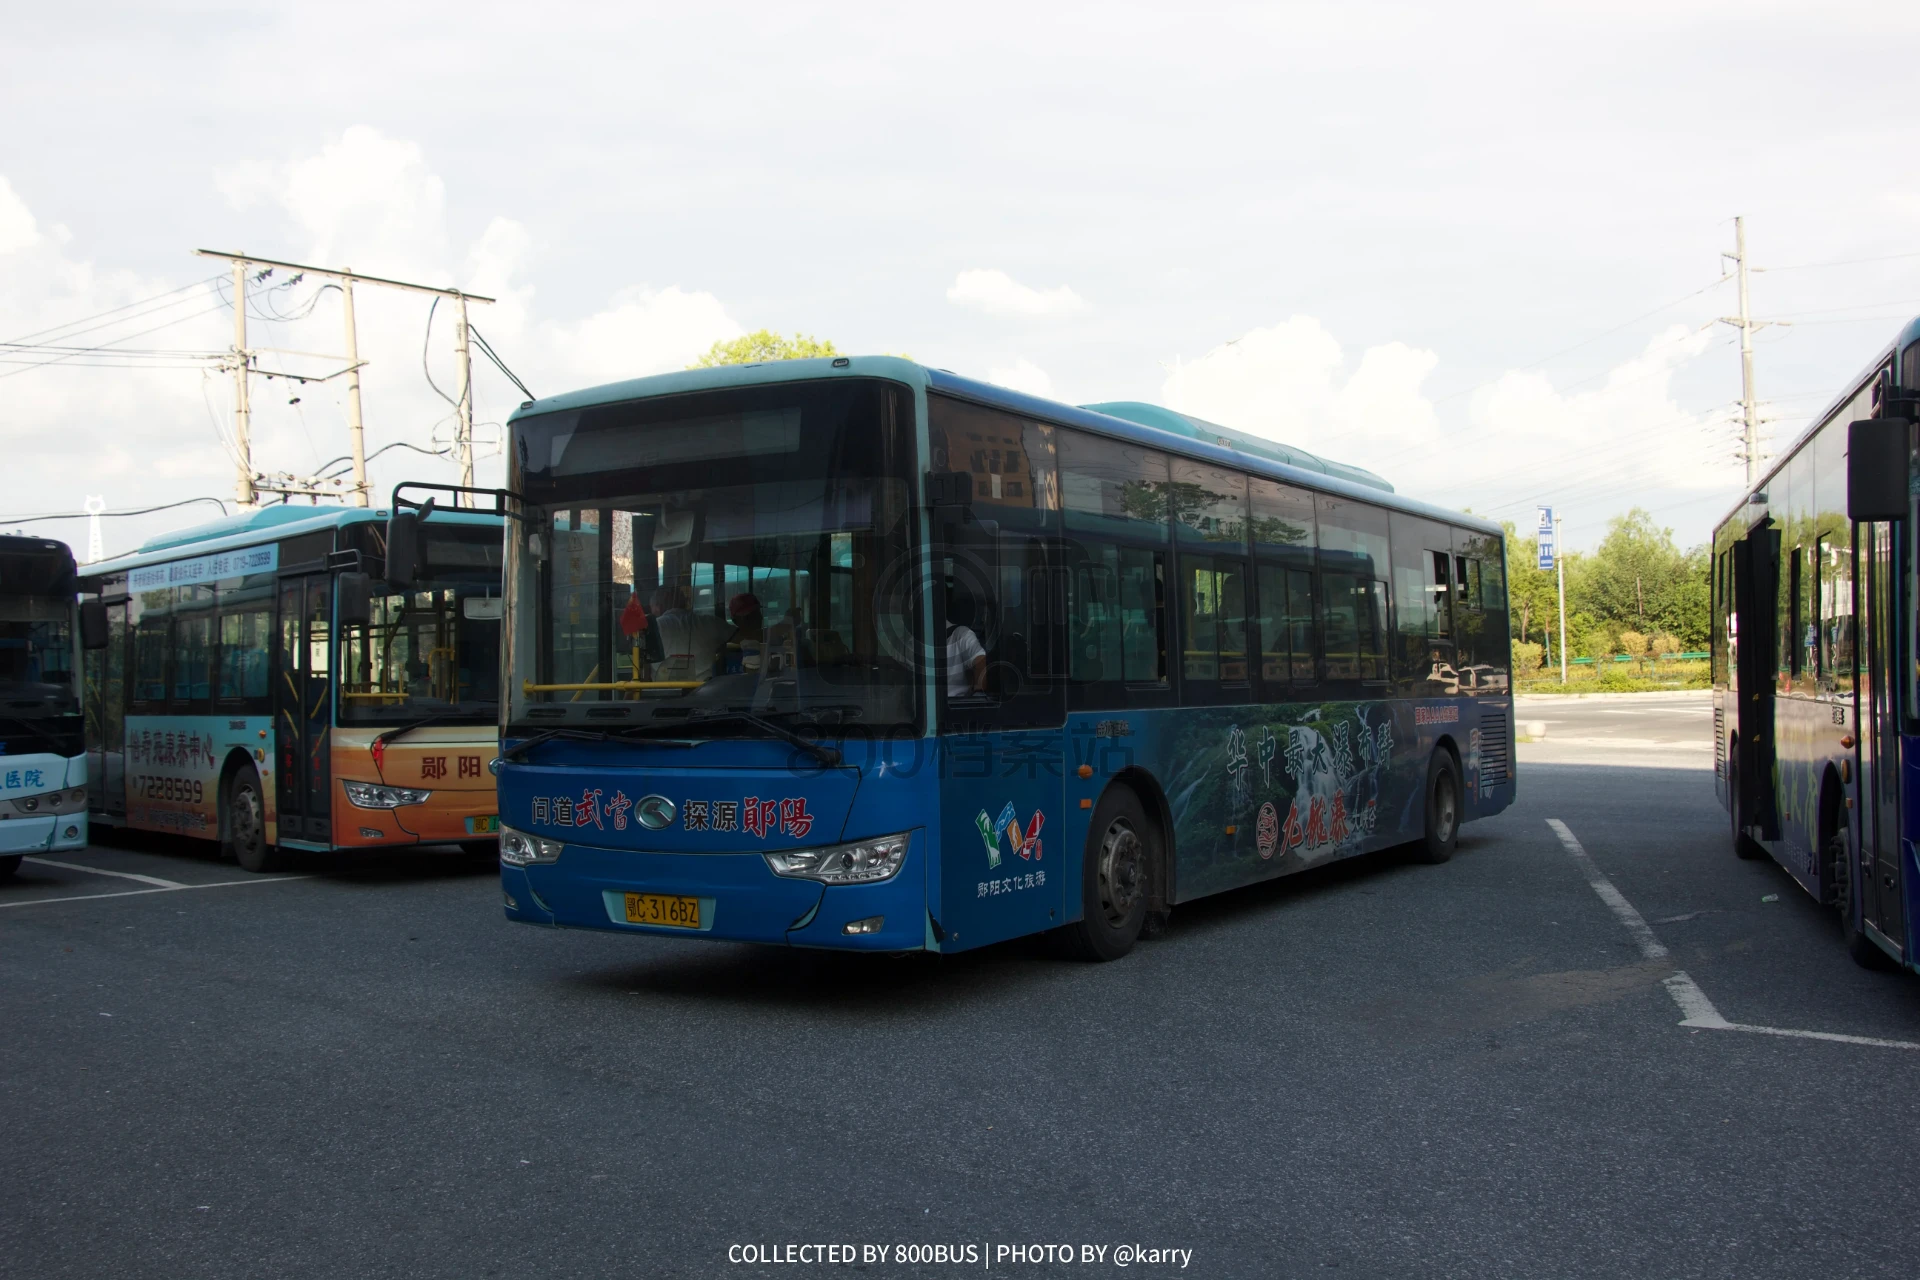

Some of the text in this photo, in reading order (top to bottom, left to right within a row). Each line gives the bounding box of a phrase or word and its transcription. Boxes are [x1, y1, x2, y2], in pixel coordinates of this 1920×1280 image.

[0, 769, 45, 789] 医院
[421, 756, 482, 780] 郧阳
[138, 775, 203, 804] 7228599
